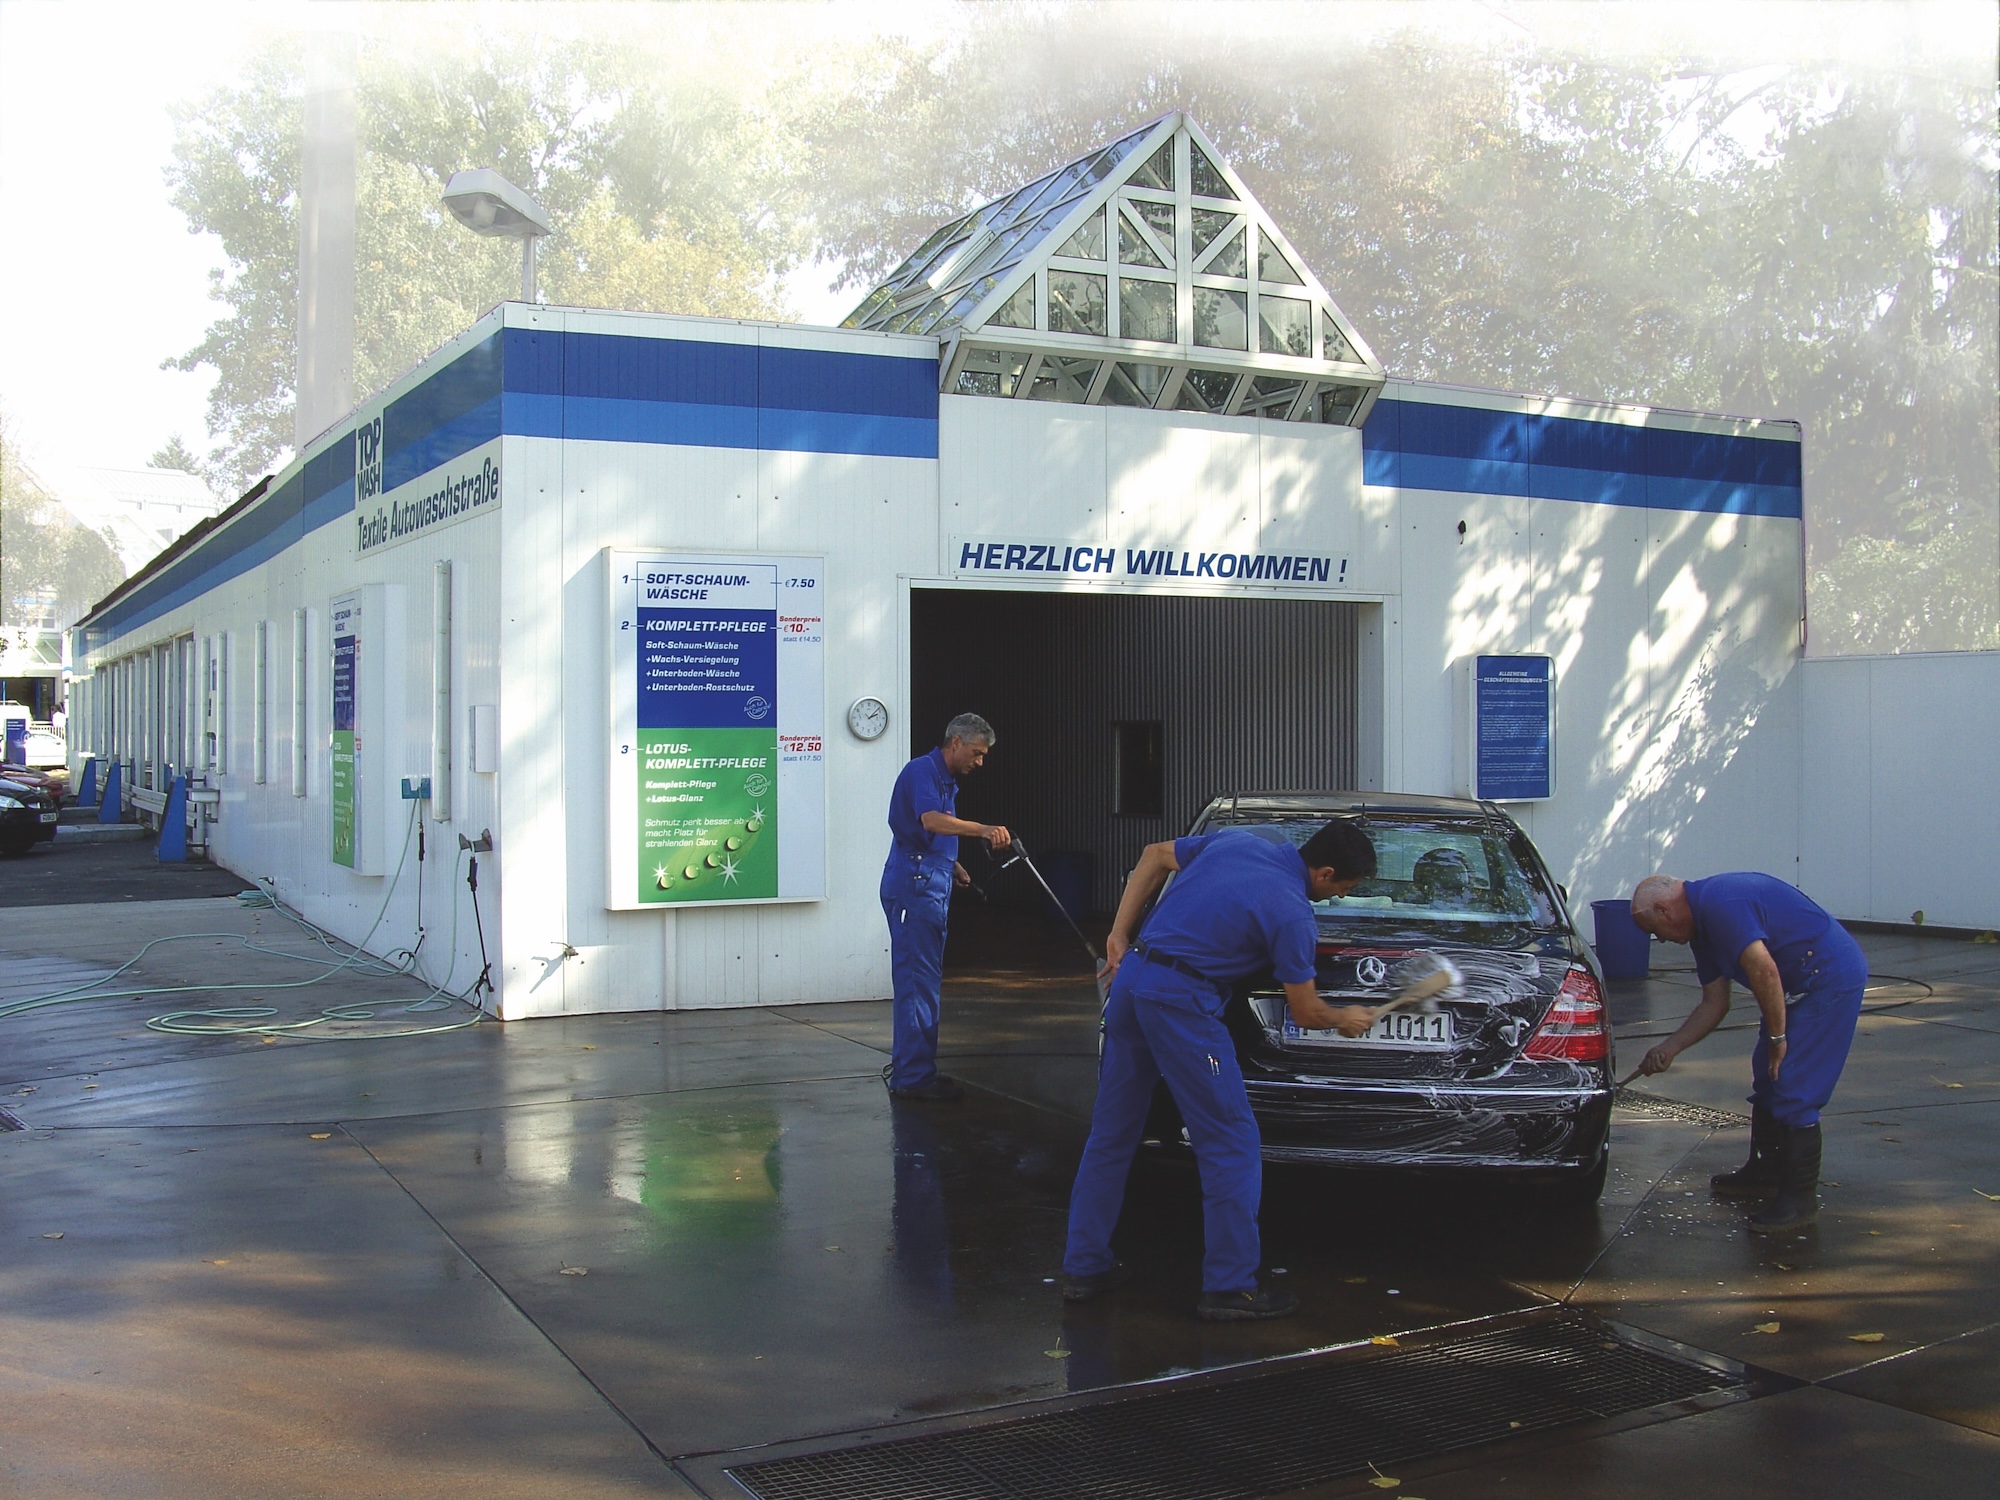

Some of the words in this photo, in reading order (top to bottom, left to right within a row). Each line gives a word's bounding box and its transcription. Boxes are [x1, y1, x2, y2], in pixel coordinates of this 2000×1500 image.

[358, 416, 381, 471] TOP
[357, 462, 381, 502] WASH
[358, 507, 388, 552] Textile
[390, 456, 499, 540] Autowaschstraße
[959, 542, 1116, 574] HERZLICH
[1126, 549, 1331, 583] WILLKOMMEN
[1338, 559, 1348, 583] !
[622, 575, 629, 584] 1
[646, 573, 750, 586] SOFT-SCHAUM-
[785, 579, 815, 588] €7.50
[646, 586, 708, 600] WÄSCHE
[779, 615, 821, 624] Sonderpreis
[621, 621, 629, 630] 2
[646, 620, 767, 633] KOMPLETT-PFLEGE
[645, 640, 739, 650] Soft-Schaum-Wäsche
[646, 655, 739, 665] +Wachs-Versiegelung
[779, 735, 822, 743] Sonderpreis
[621, 745, 629, 754] 3
[645, 743, 692, 755] LOTUS-
[783, 742, 822, 752] €12.50
[645, 758, 767, 770] KOMPLETT-PFLEGE
[645, 780, 717, 790] Komplett-Pflege
[645, 818, 680, 827] Schmutz
[704, 818, 732, 826] besser
[733, 817, 744, 825] ab
[645, 828, 671, 837] macht
[673, 828, 695, 837] Platz
[696, 828, 708, 837] für
[645, 839, 694, 848] strahlenden
[695, 838, 718, 847] Glanz
[1380, 1014, 1445, 1042] 1011
